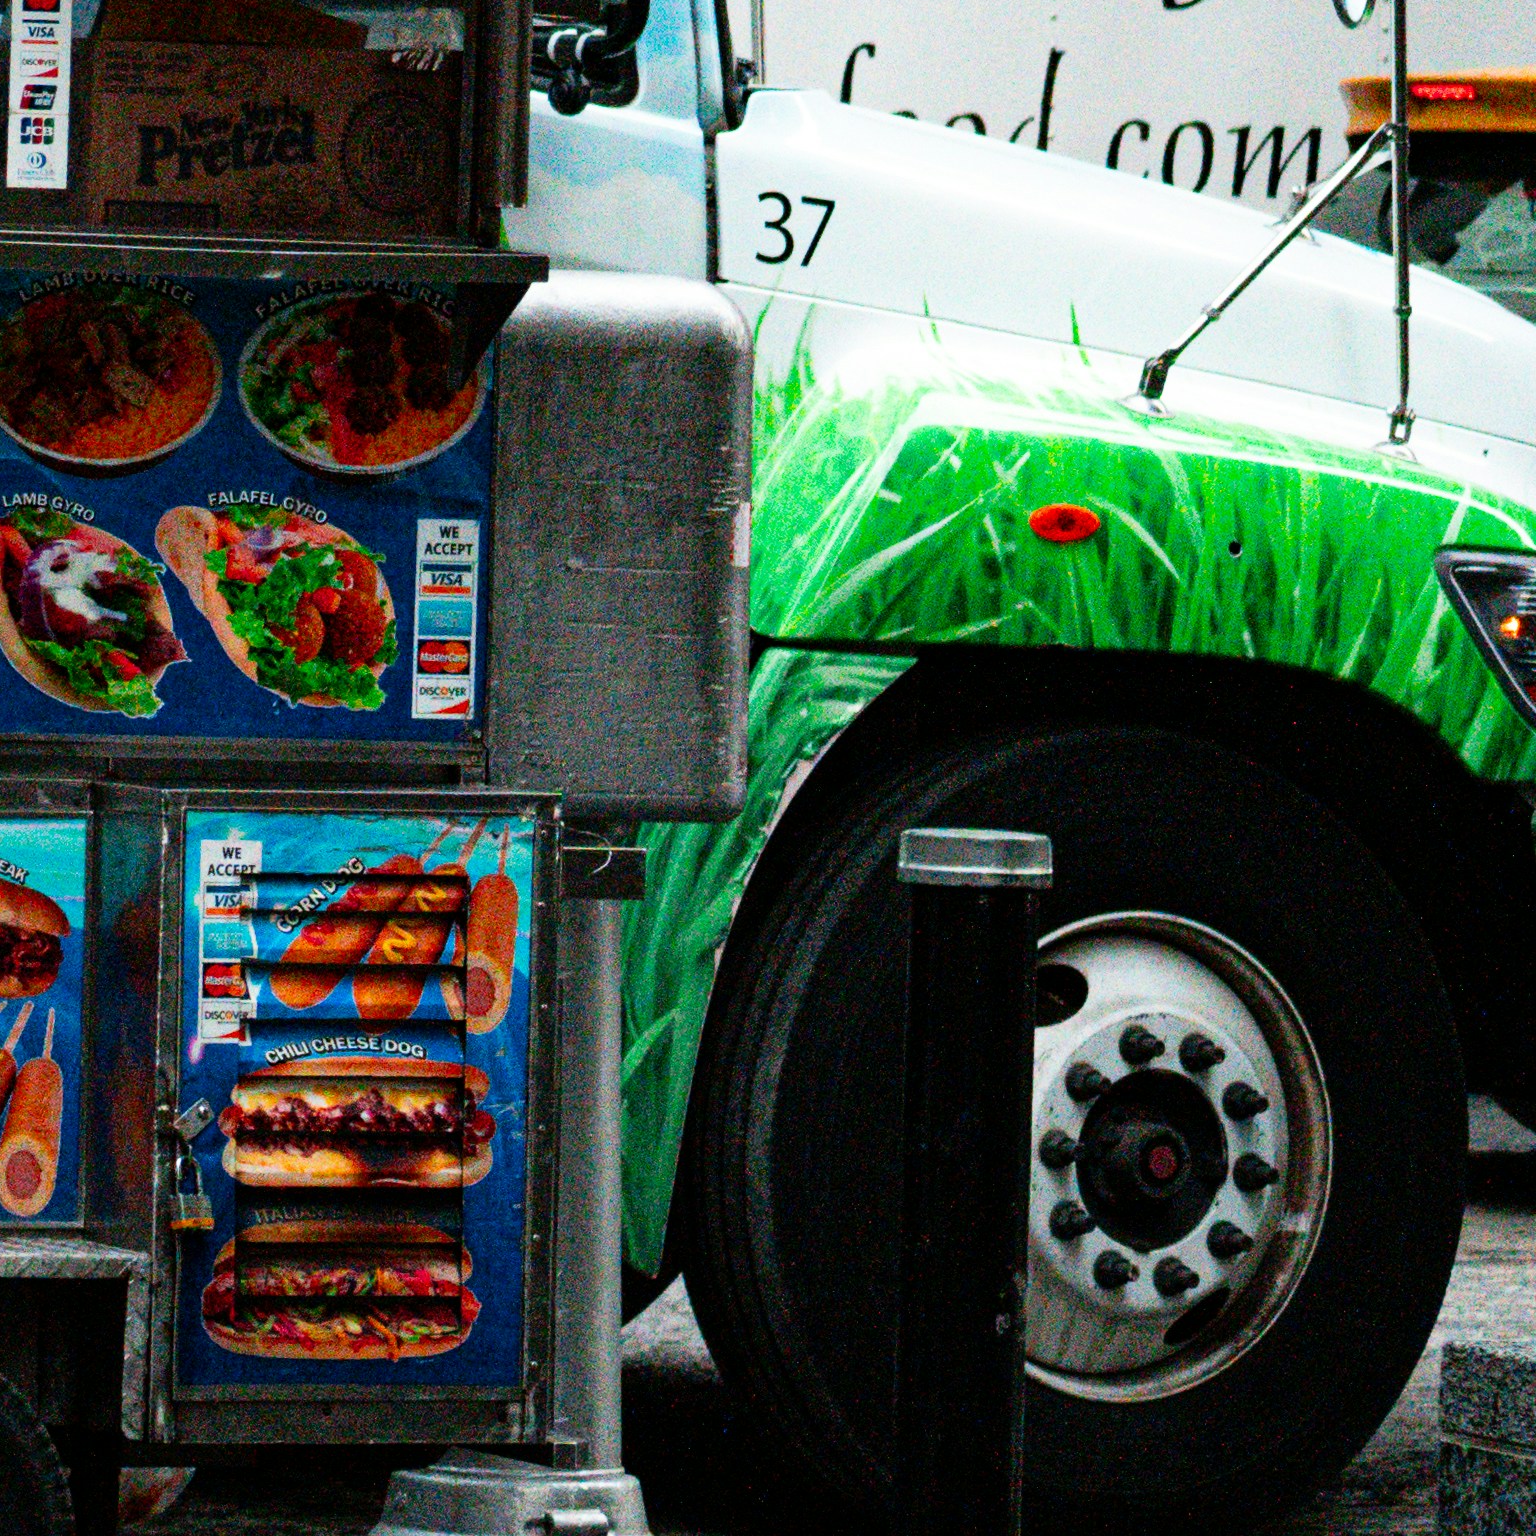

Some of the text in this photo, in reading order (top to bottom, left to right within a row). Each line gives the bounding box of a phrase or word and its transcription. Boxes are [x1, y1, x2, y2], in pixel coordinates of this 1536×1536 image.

[28, 26, 56, 38] VISA
[22, 58, 57, 67] DISCOVER
[20, 126, 55, 136] JCB
[136, 110, 316, 186] Pretzel
[754, 190, 836, 268] 37
[18, 272, 198, 306] LAMB RICE
[1, 490, 97, 523] LAMB GYRO
[206, 489, 330, 524] FALAFEL GYRO
[439, 525, 460, 539] WE
[424, 542, 474, 556] ACCEPT
[431, 572, 464, 586] VISA
[420, 651, 468, 663] MasterCard
[418, 686, 467, 697] DISCOVER
[222, 847, 243, 861] WE
[207, 863, 256, 878] ACCEPT
[214, 893, 243, 907] VISA
[264, 1034, 428, 1065] CHILI CHEESE DOG
